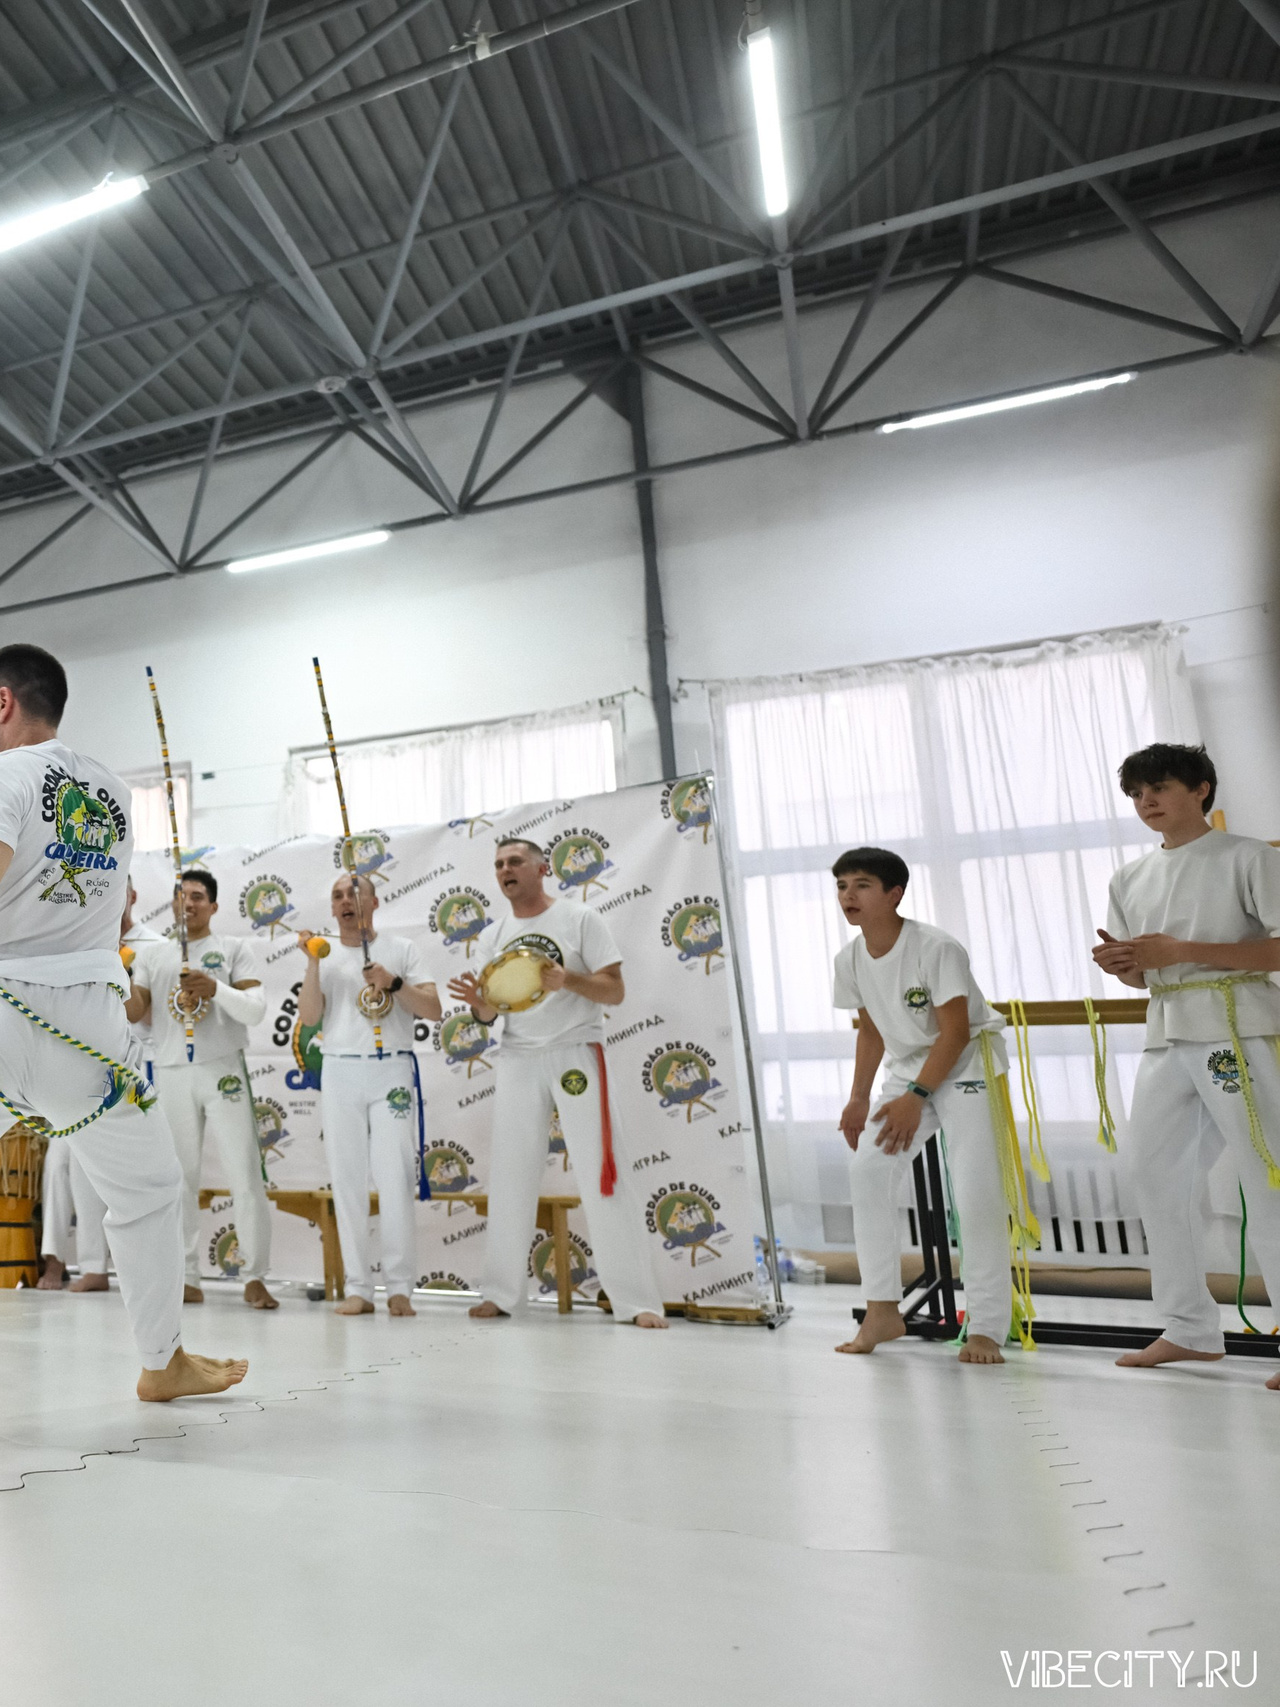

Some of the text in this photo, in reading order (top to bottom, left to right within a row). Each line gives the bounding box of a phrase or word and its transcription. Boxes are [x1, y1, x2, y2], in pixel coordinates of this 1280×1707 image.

[97, 788, 126, 841] OURO
[544, 834, 562, 877] CDÃO
[563, 827, 578, 837] DE
[581, 828, 610, 850] OURO
[256, 874, 268, 882] DE
[270, 874, 292, 895] OURO
[383, 862, 455, 904] КАЛИНИНГРАД
[429, 891, 447, 933] CORDÃO
[448, 885, 462, 895] DE
[464, 886, 491, 908] OURO
[660, 902, 682, 947] CORDÃO
[683, 895, 700, 905] DE
[453, 1005, 467, 1014] DE
[641, 1046, 664, 1093] CORDÃO
[665, 1040, 682, 1051] DE
[685, 1041, 716, 1068] OURO
[265, 1097, 288, 1120] OURO
[431, 1139, 474, 1165] DE OURO
[645, 1181, 721, 1234] CORDÃO DE OURO
[208, 1227, 227, 1266] CORDÃO
[442, 1220, 488, 1246] КАЛИНИ
[430, 1270, 444, 1280] DE
